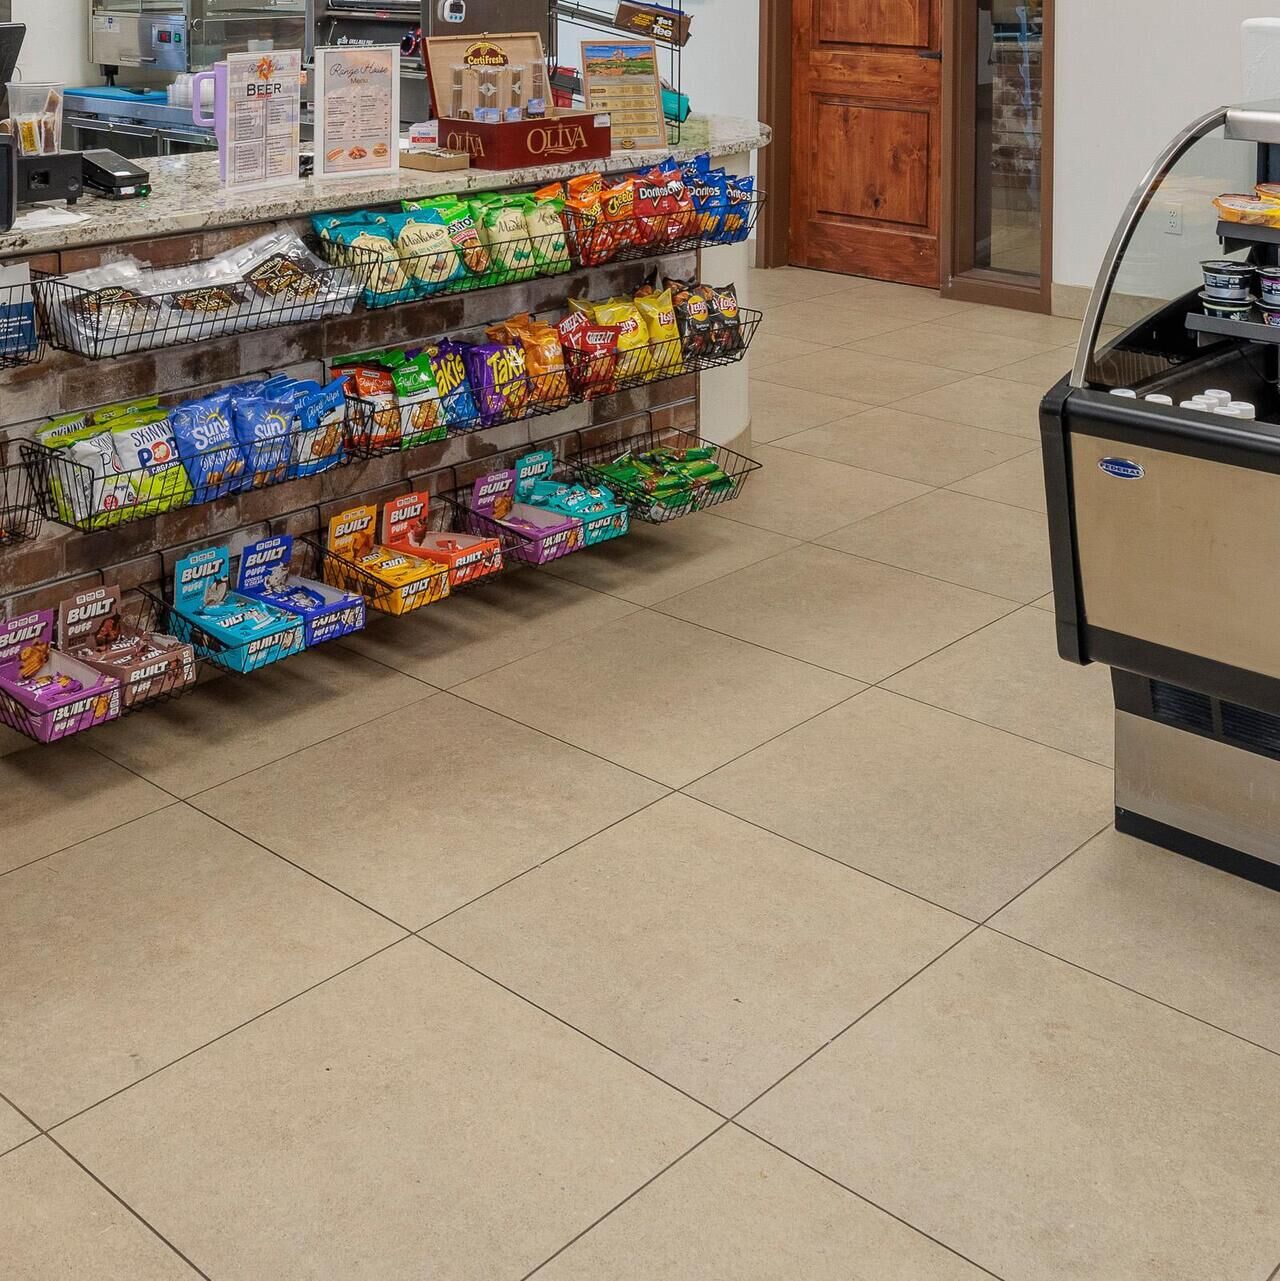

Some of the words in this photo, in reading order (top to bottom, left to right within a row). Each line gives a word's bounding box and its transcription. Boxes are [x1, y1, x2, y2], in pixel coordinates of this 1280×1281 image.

[652, 24, 673, 37] Tee
[330, 63, 359, 78] Range
[361, 62, 389, 74] House
[467, 54, 505, 66] CertiFresh
[246, 83, 282, 97] BEER
[446, 130, 486, 158] OLIVA
[526, 123, 589, 154] OLIVA
[639, 185, 668, 200] Doritos
[608, 190, 634, 216] Cheeto
[585, 330, 616, 345] CHEEZ-IT
[192, 419, 229, 451] Sun
[208, 431, 231, 444] CHIPS
[254, 420, 282, 447] Sun
[519, 461, 550, 480] BUILT
[478, 479, 513, 497] BUILT
[390, 502, 424, 524] BUILT
[335, 515, 372, 538] BUILT
[246, 545, 288, 568] BUILT
[181, 558, 224, 583] BUILT
[245, 564, 266, 578] PUFF
[182, 581, 203, 594] PUFF
[67, 597, 116, 624] BUILT
[68, 622, 93, 636] PUFF
[130, 660, 169, 682] BUILT
[53, 697, 95, 722] BUILT
